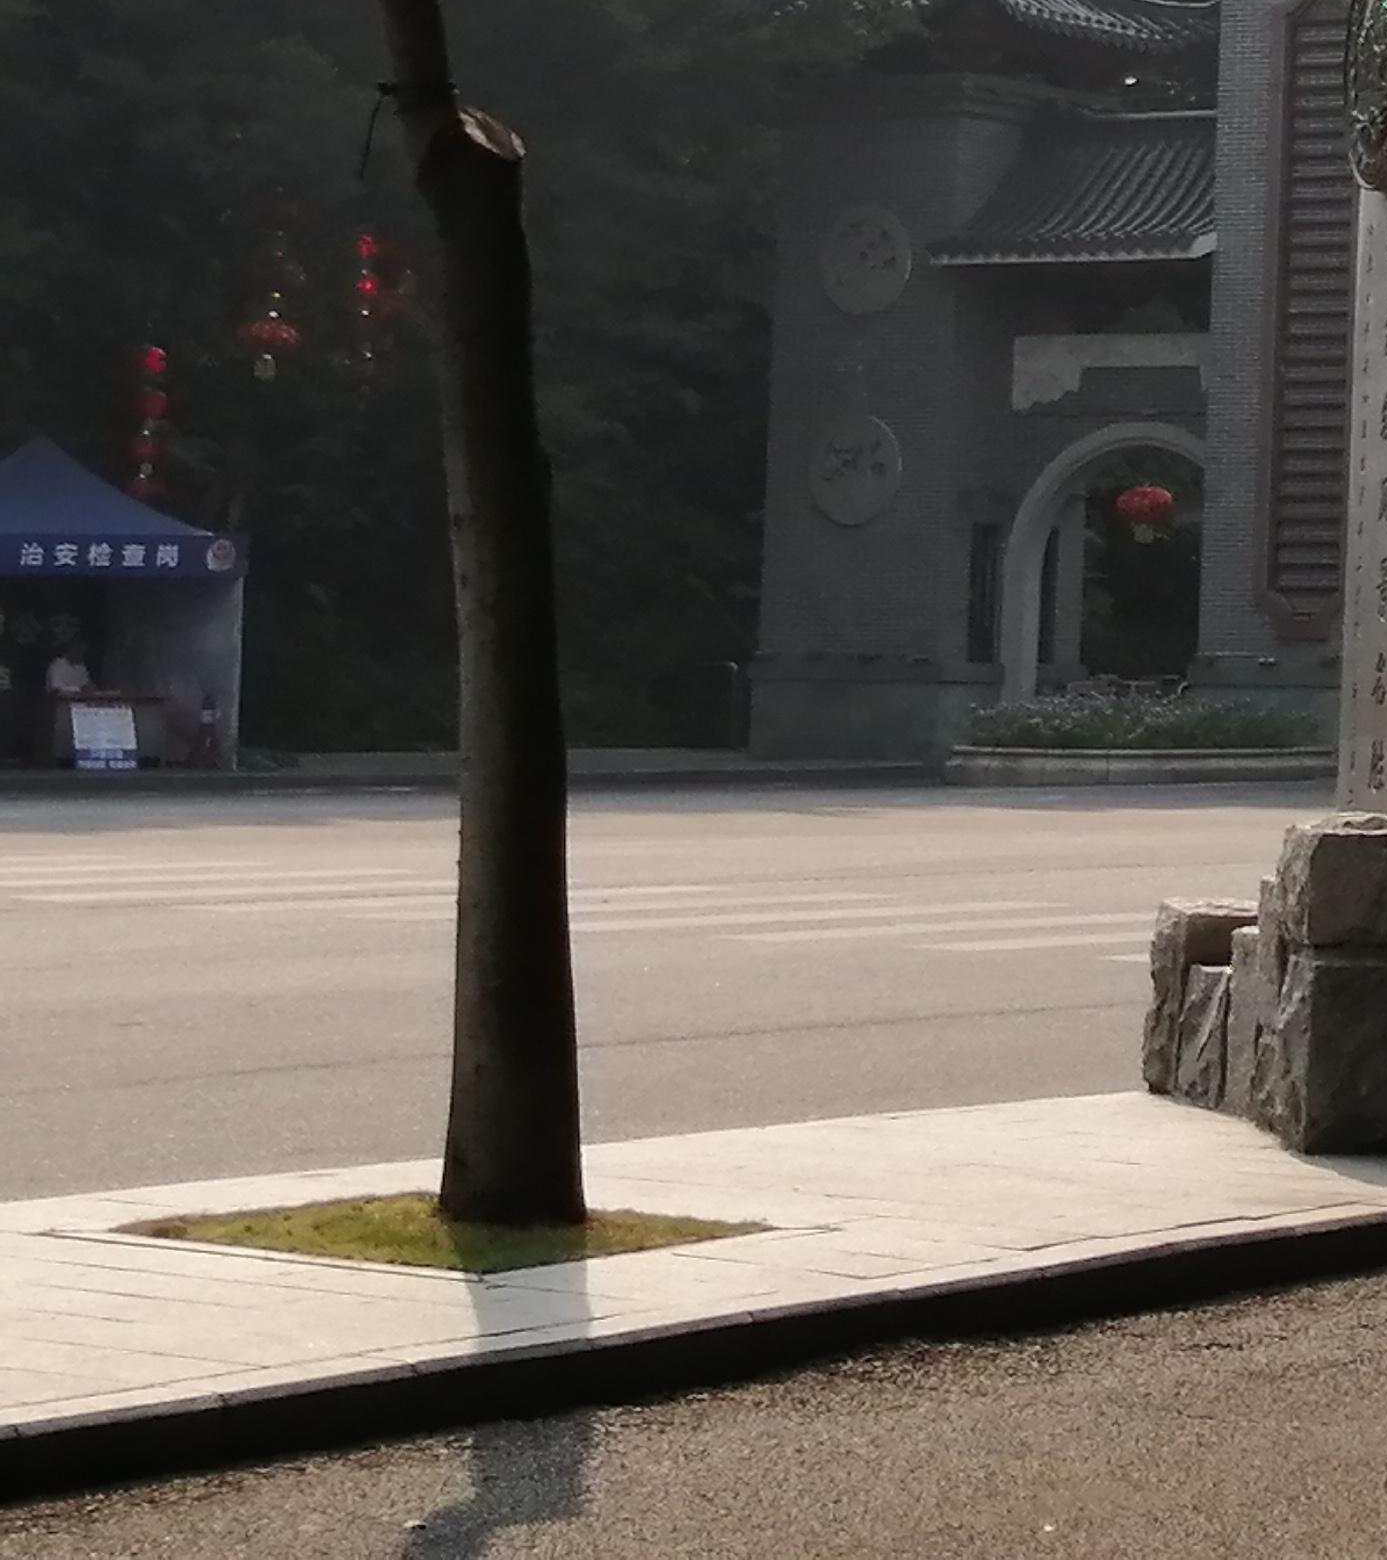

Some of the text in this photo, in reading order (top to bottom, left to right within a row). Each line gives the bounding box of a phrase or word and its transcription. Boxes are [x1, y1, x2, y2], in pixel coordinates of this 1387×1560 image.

[19, 542, 181, 569] 治安检查岗
